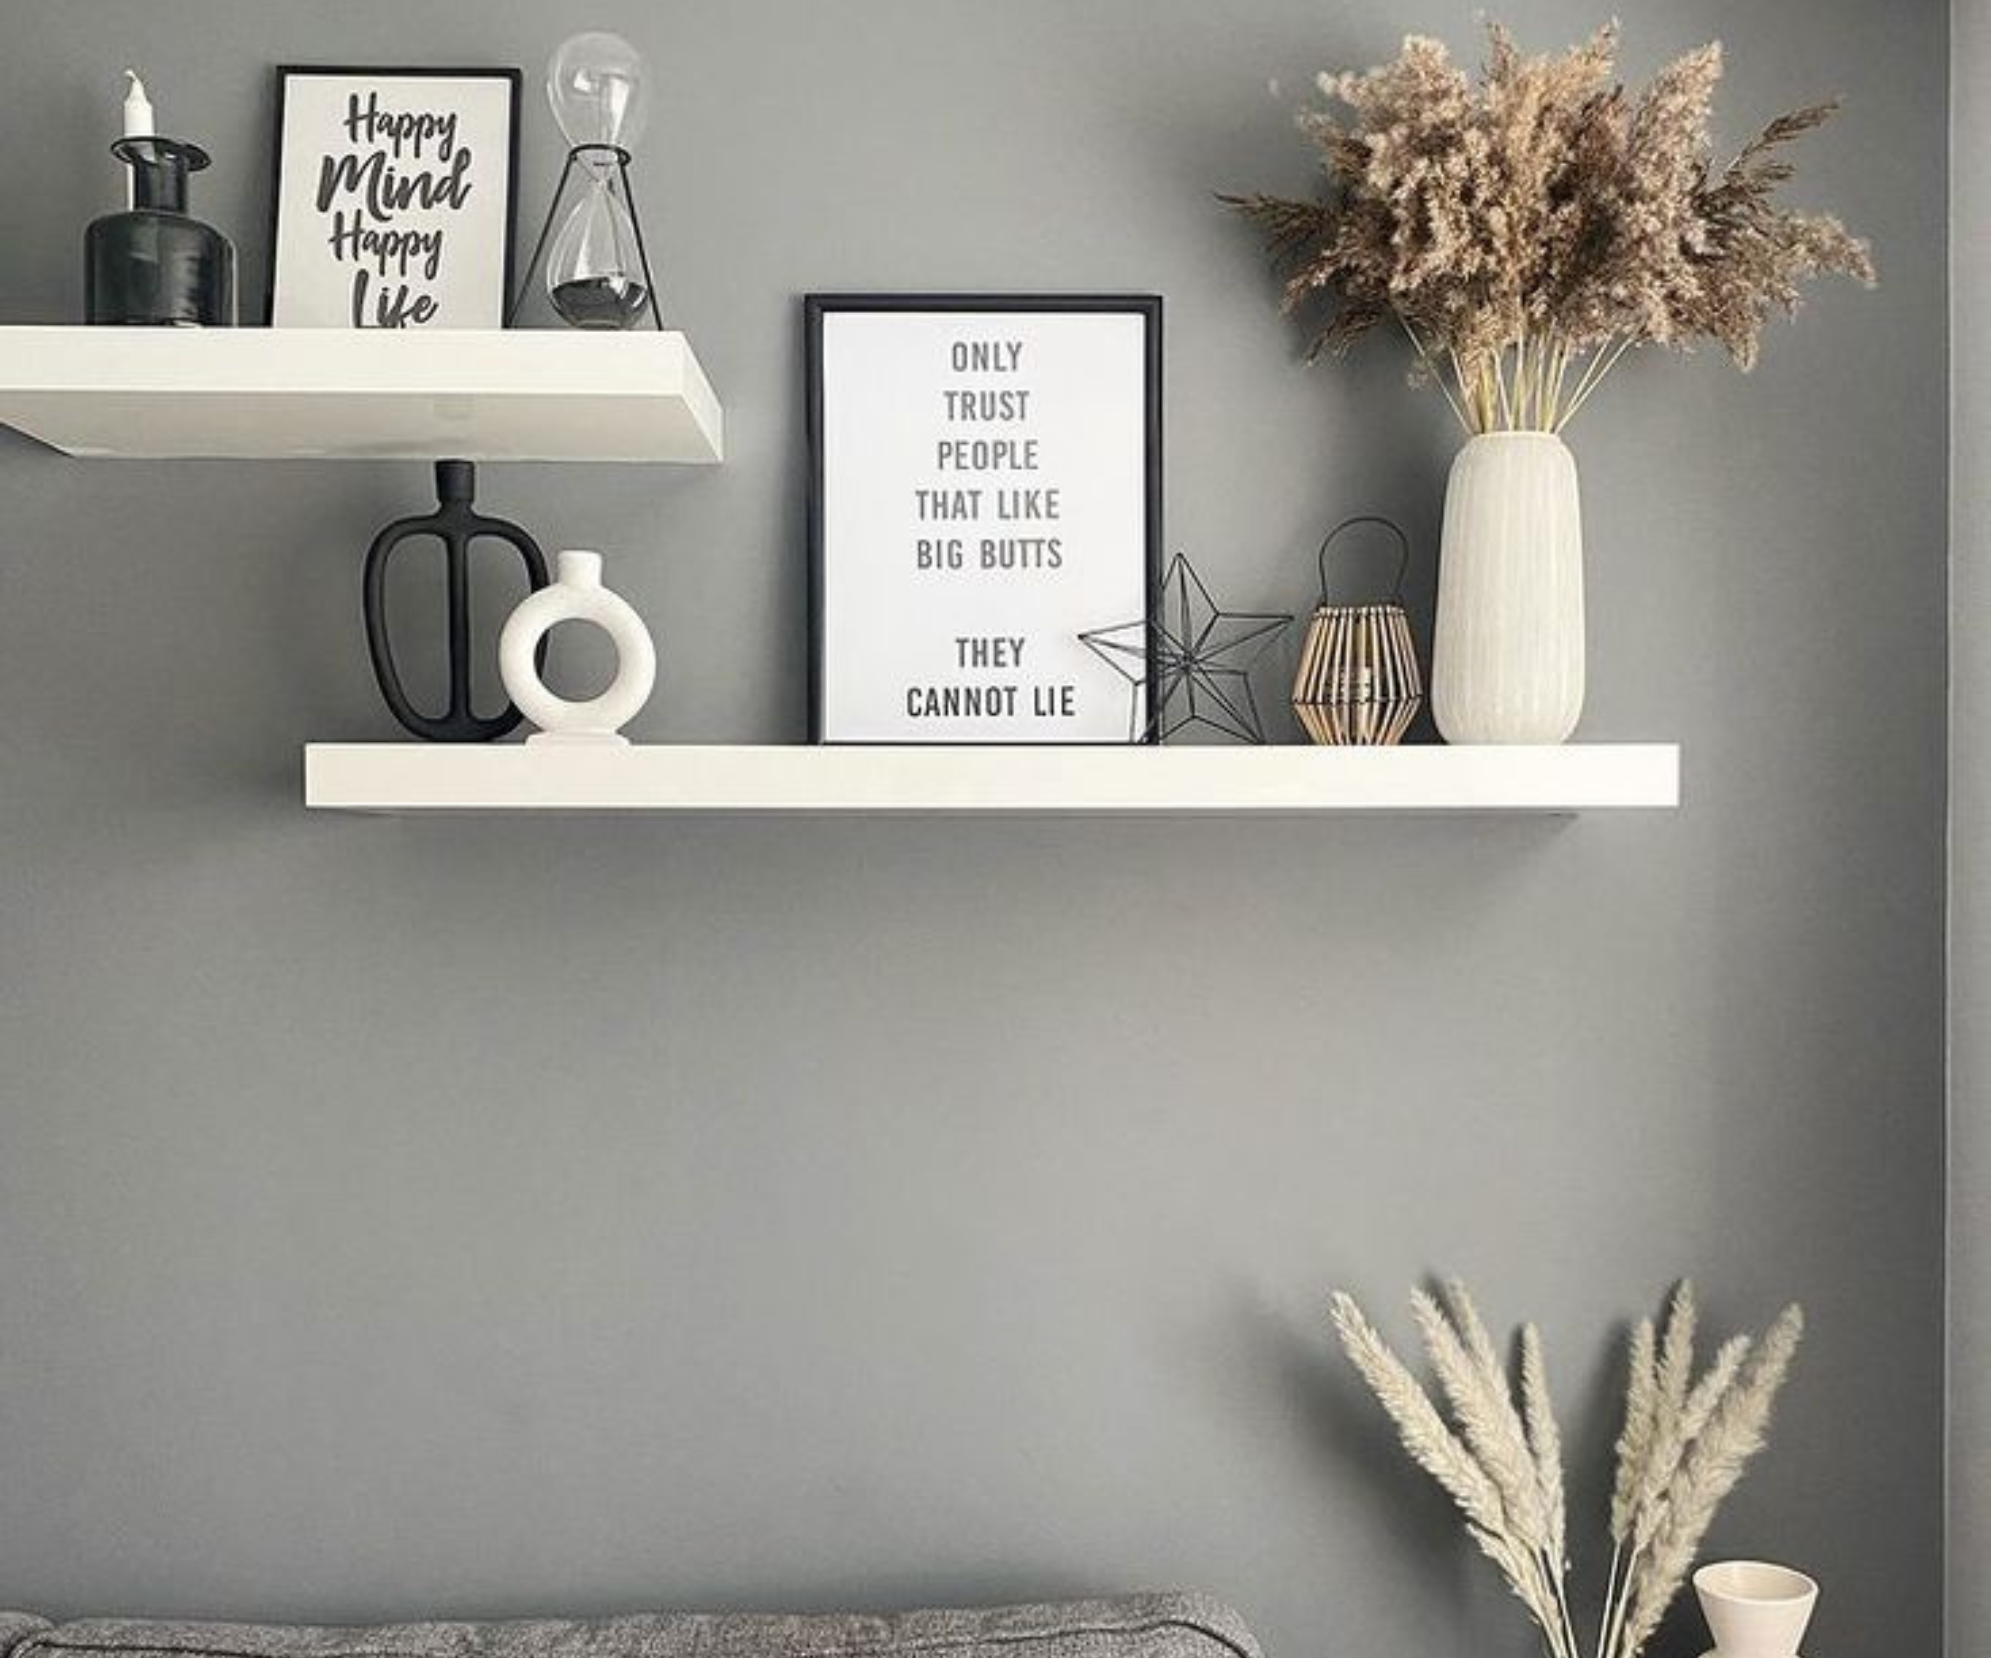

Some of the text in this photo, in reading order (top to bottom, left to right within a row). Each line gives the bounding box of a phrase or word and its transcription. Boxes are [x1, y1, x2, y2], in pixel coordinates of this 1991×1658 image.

[343, 91, 457, 163] Happy
[316, 146, 472, 223] Mind
[328, 208, 443, 281] Happy
[352, 267, 439, 328] Life
[951, 341, 1023, 372] ONLY
[943, 390, 1030, 422] TRUST
[937, 440, 1039, 471] PEOPLE
[915, 489, 1061, 521] THAT LIKE
[917, 538, 1063, 570] BIG BUTTS
[955, 637, 1026, 668] THEY
[906, 685, 1076, 718] CANNOT LIE
